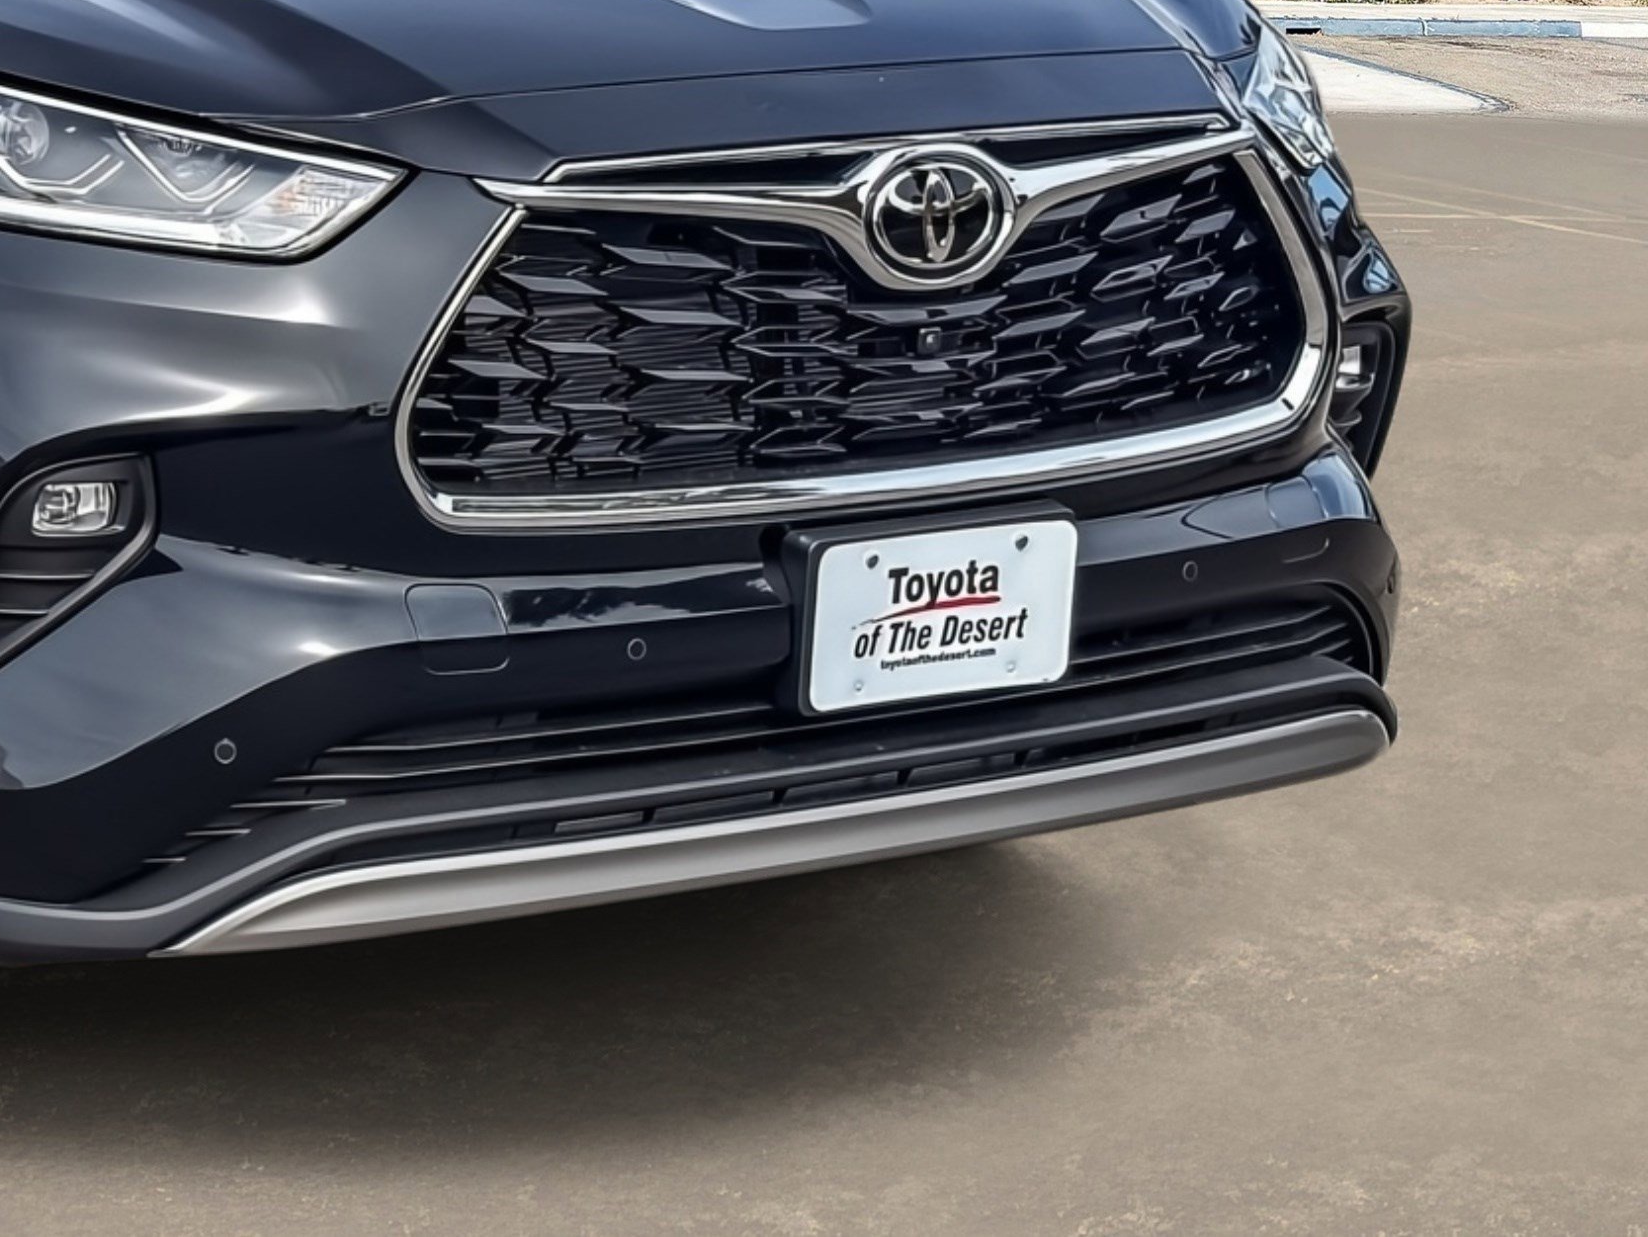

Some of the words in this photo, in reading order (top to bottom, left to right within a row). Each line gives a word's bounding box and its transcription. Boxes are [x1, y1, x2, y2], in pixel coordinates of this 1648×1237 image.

[888, 560, 1000, 608] Toyota
[854, 622, 885, 660] of
[888, 619, 932, 654] The
[940, 608, 1028, 644] Desert
[880, 647, 997, 671] toyotaofthedesert.com
